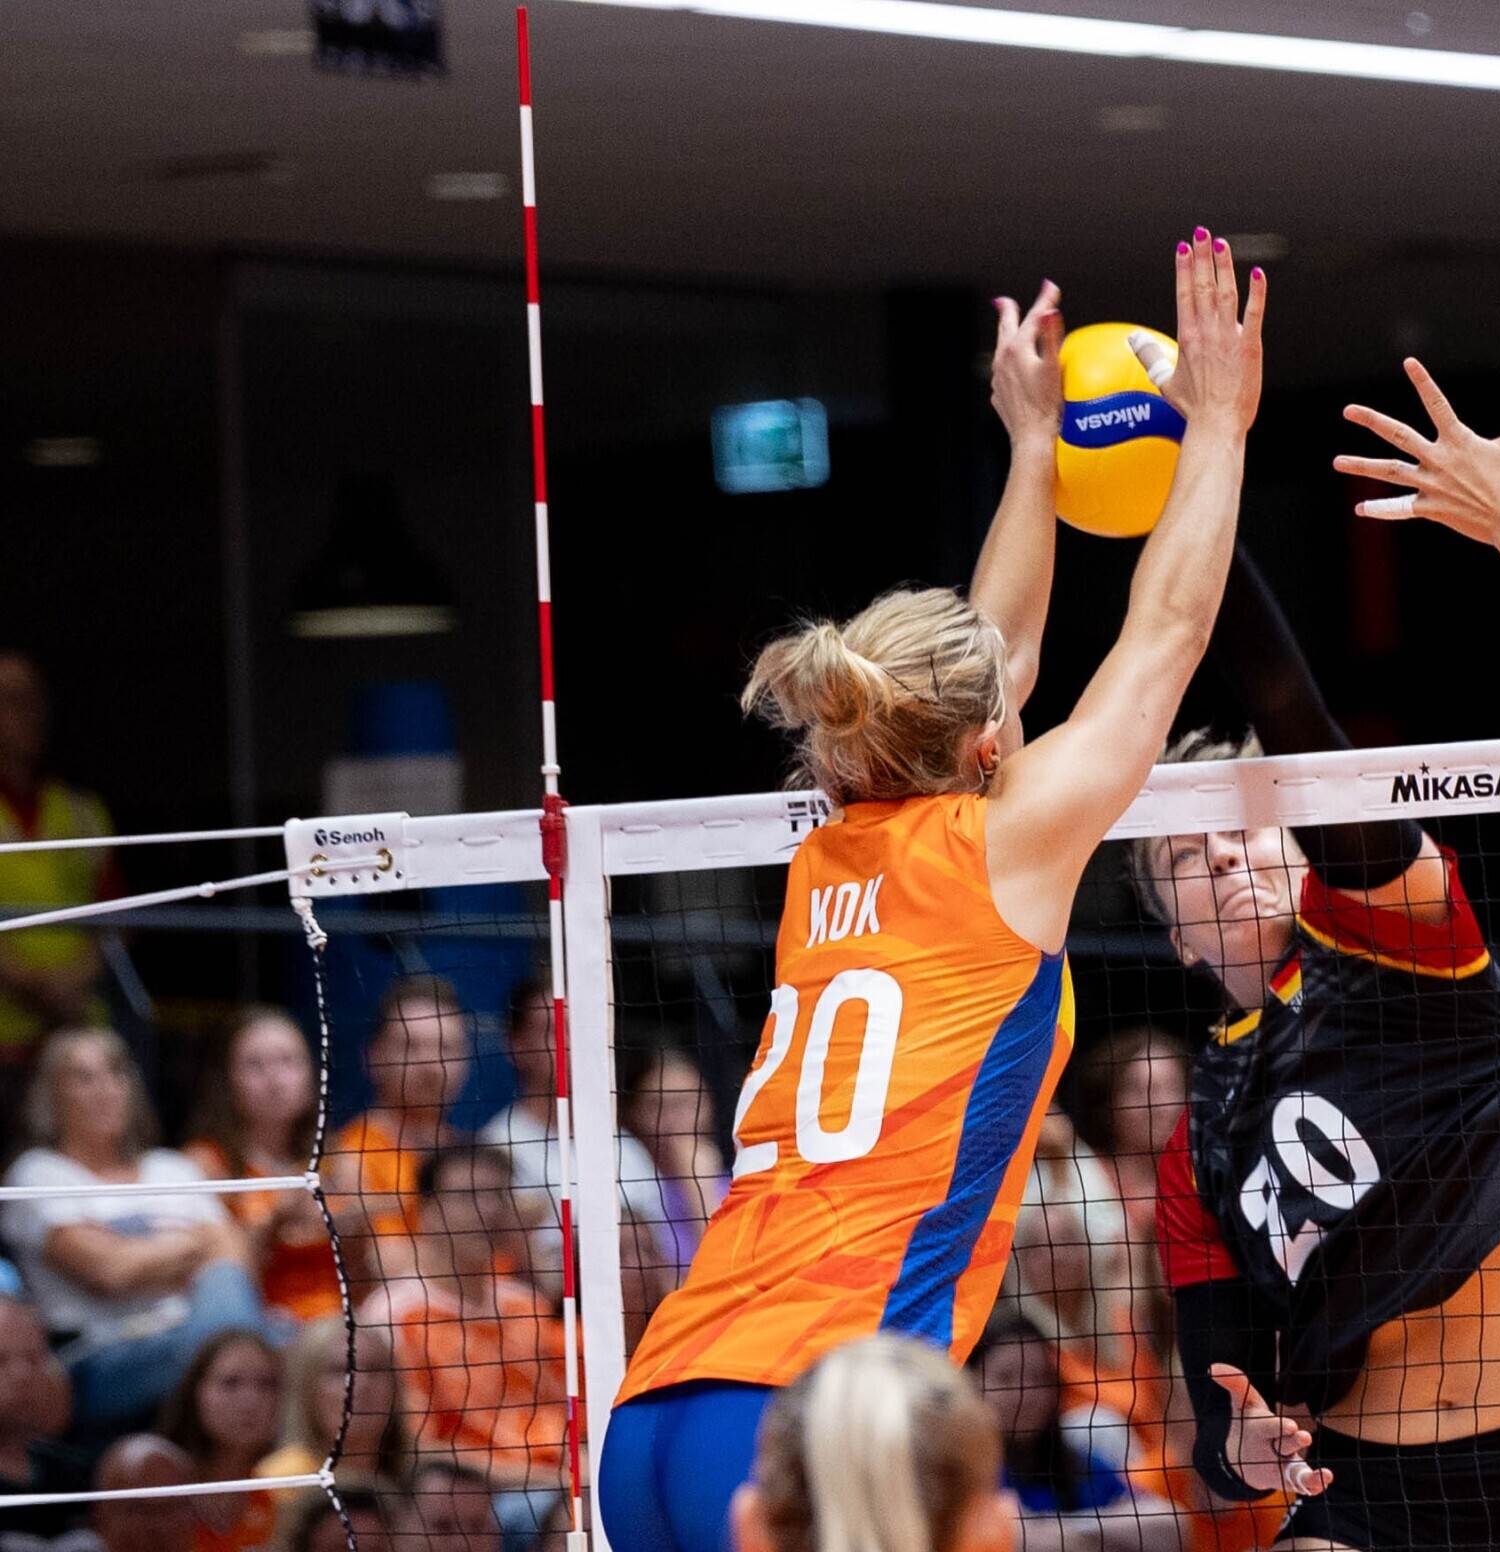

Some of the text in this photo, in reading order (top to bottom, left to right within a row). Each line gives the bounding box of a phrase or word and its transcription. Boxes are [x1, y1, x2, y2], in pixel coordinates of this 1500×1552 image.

[329, 827, 385, 845] Senoh
[806, 873, 884, 949] KOK
[732, 967, 904, 1182] 20
